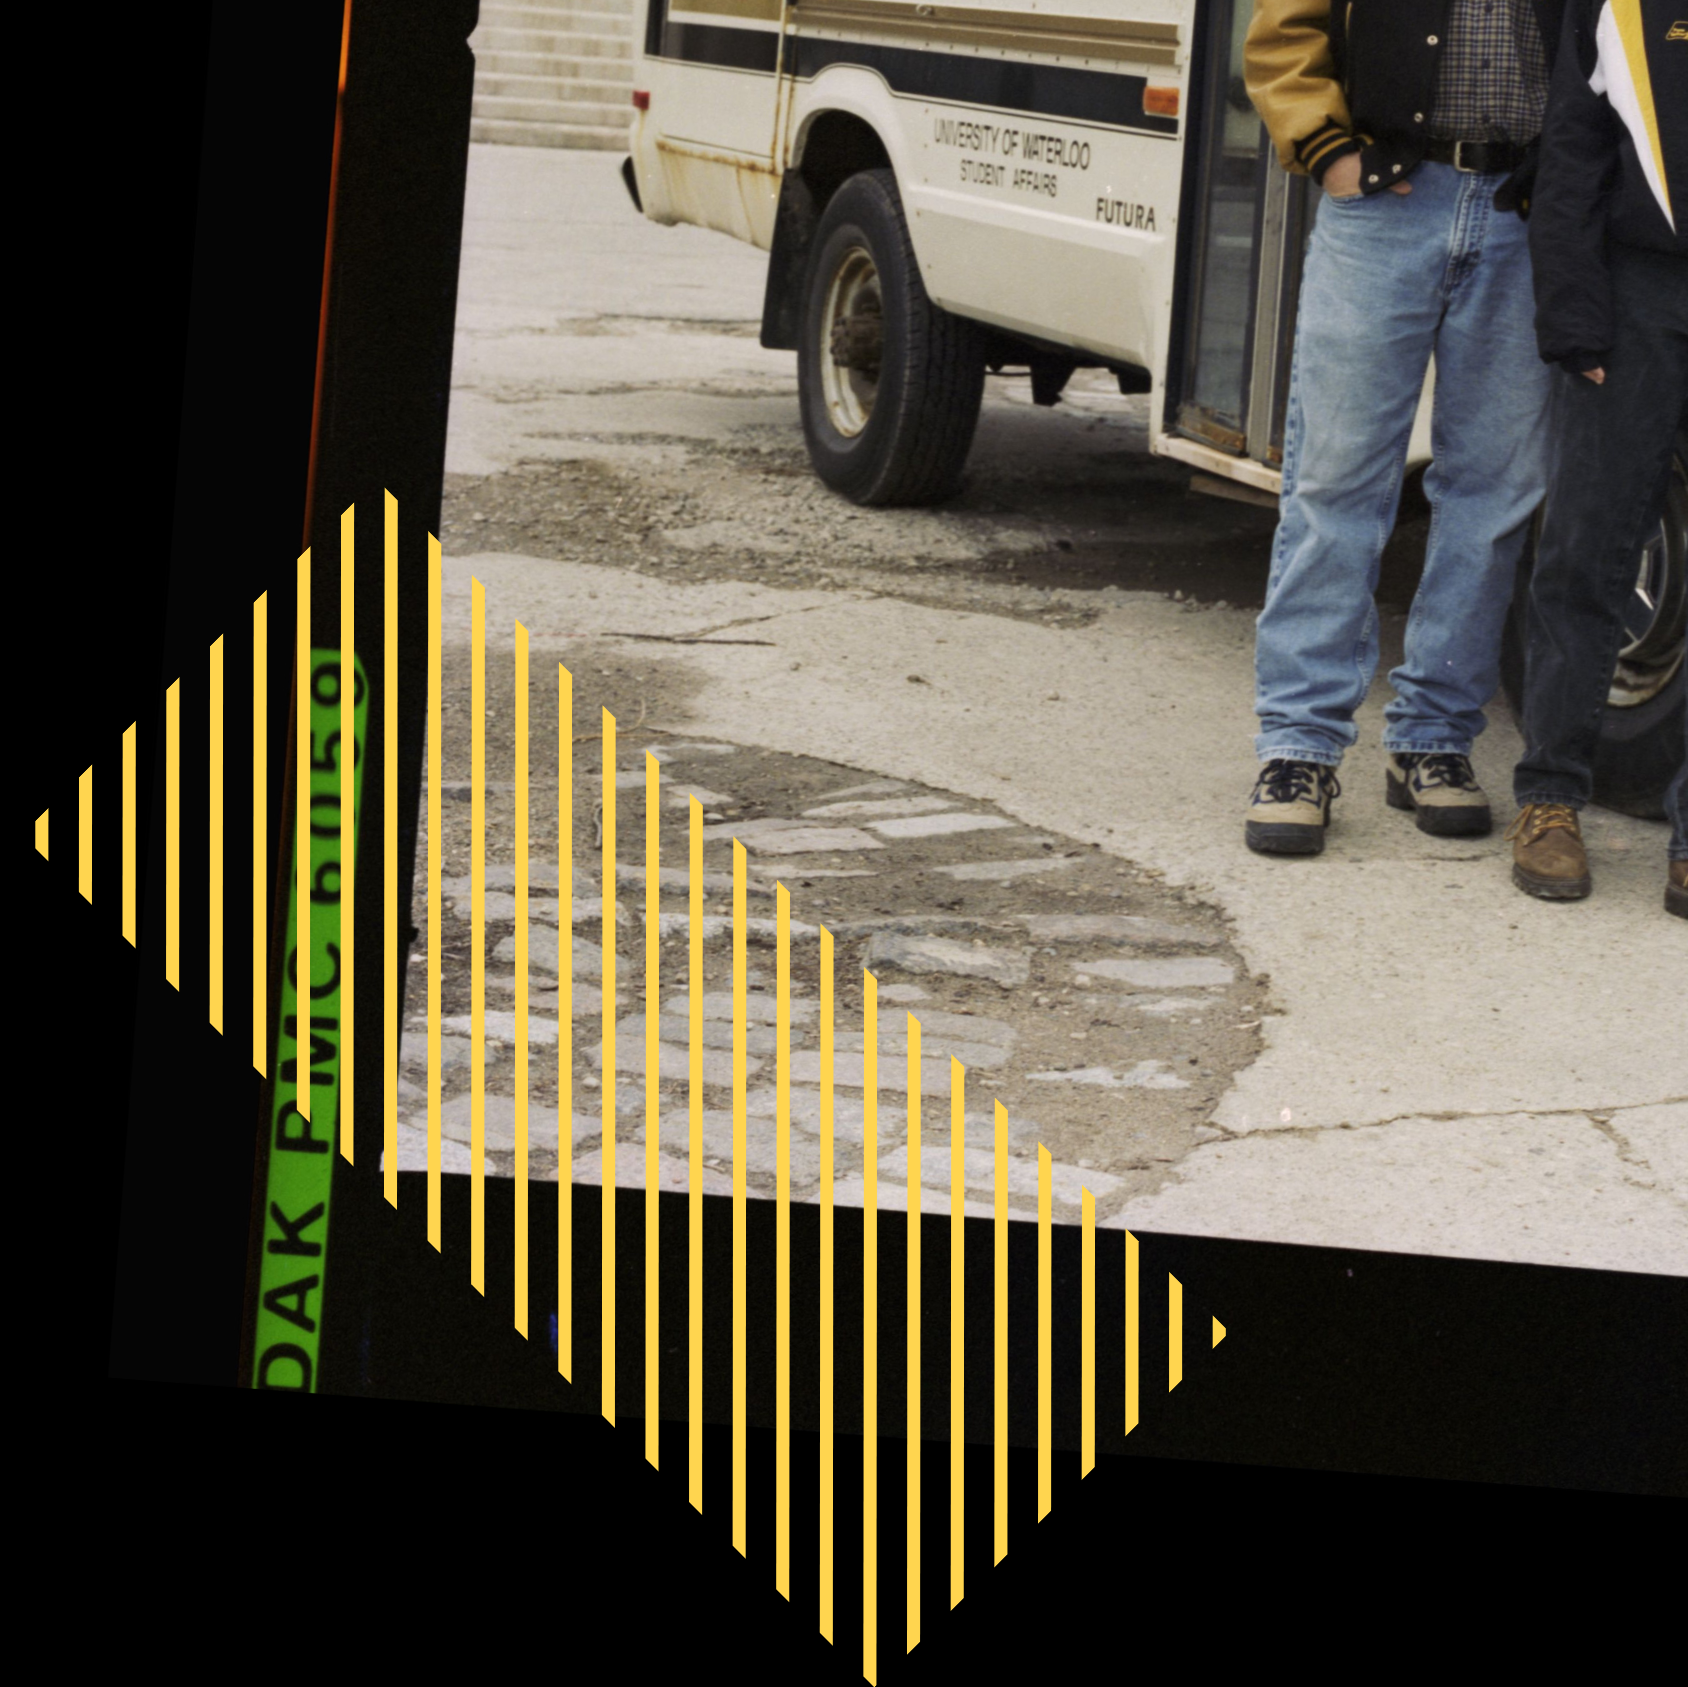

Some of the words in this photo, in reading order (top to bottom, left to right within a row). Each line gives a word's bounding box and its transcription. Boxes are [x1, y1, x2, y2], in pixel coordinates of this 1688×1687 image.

[933, 118, 1001, 154] UNIVERSITY
[1002, 128, 1019, 157] OF
[1021, 132, 1091, 171] WATERLOO
[960, 159, 1006, 188] STUDENT
[1012, 167, 1058, 198] AFFAIRS
[1095, 197, 1157, 232] FUTURA
[274, 941, 344, 1154] PMC
